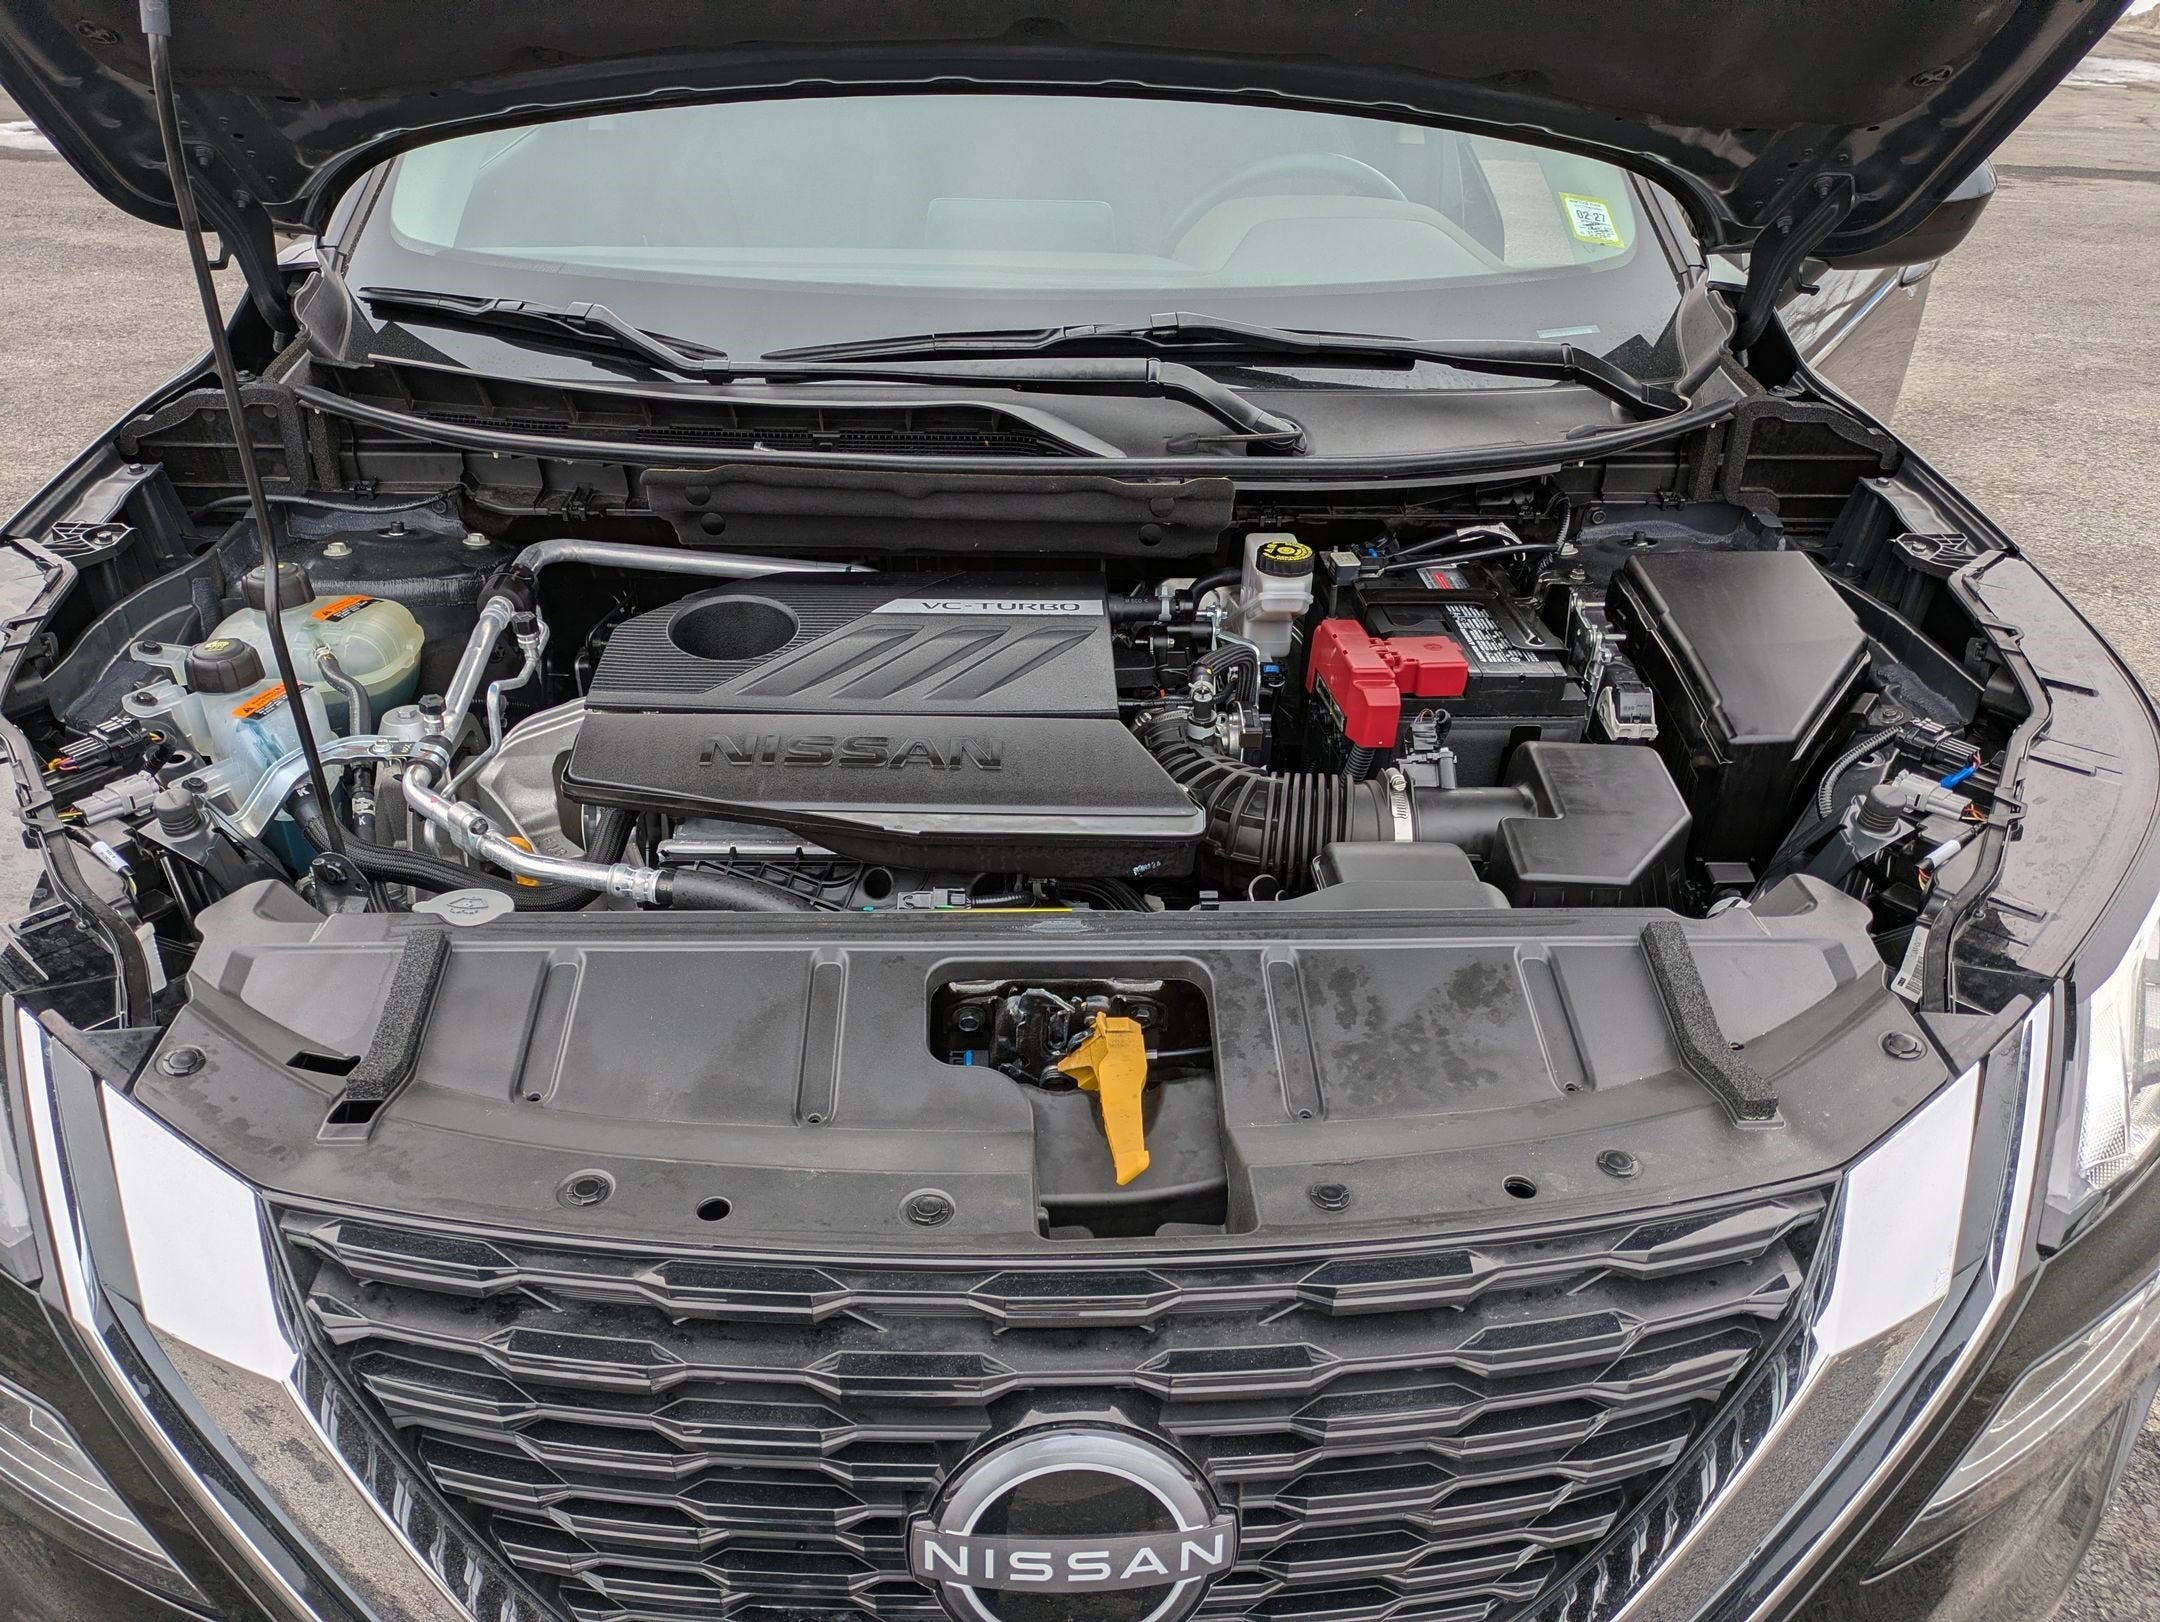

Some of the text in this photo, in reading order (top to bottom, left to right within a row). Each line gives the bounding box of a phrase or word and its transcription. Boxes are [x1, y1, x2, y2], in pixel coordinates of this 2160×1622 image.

[1576, 210, 1605, 223] 02 27
[921, 602, 1080, 612] VC-TURBO
[699, 734, 1003, 770] NISSAN
[924, 1534, 1223, 1582] NISSAN
